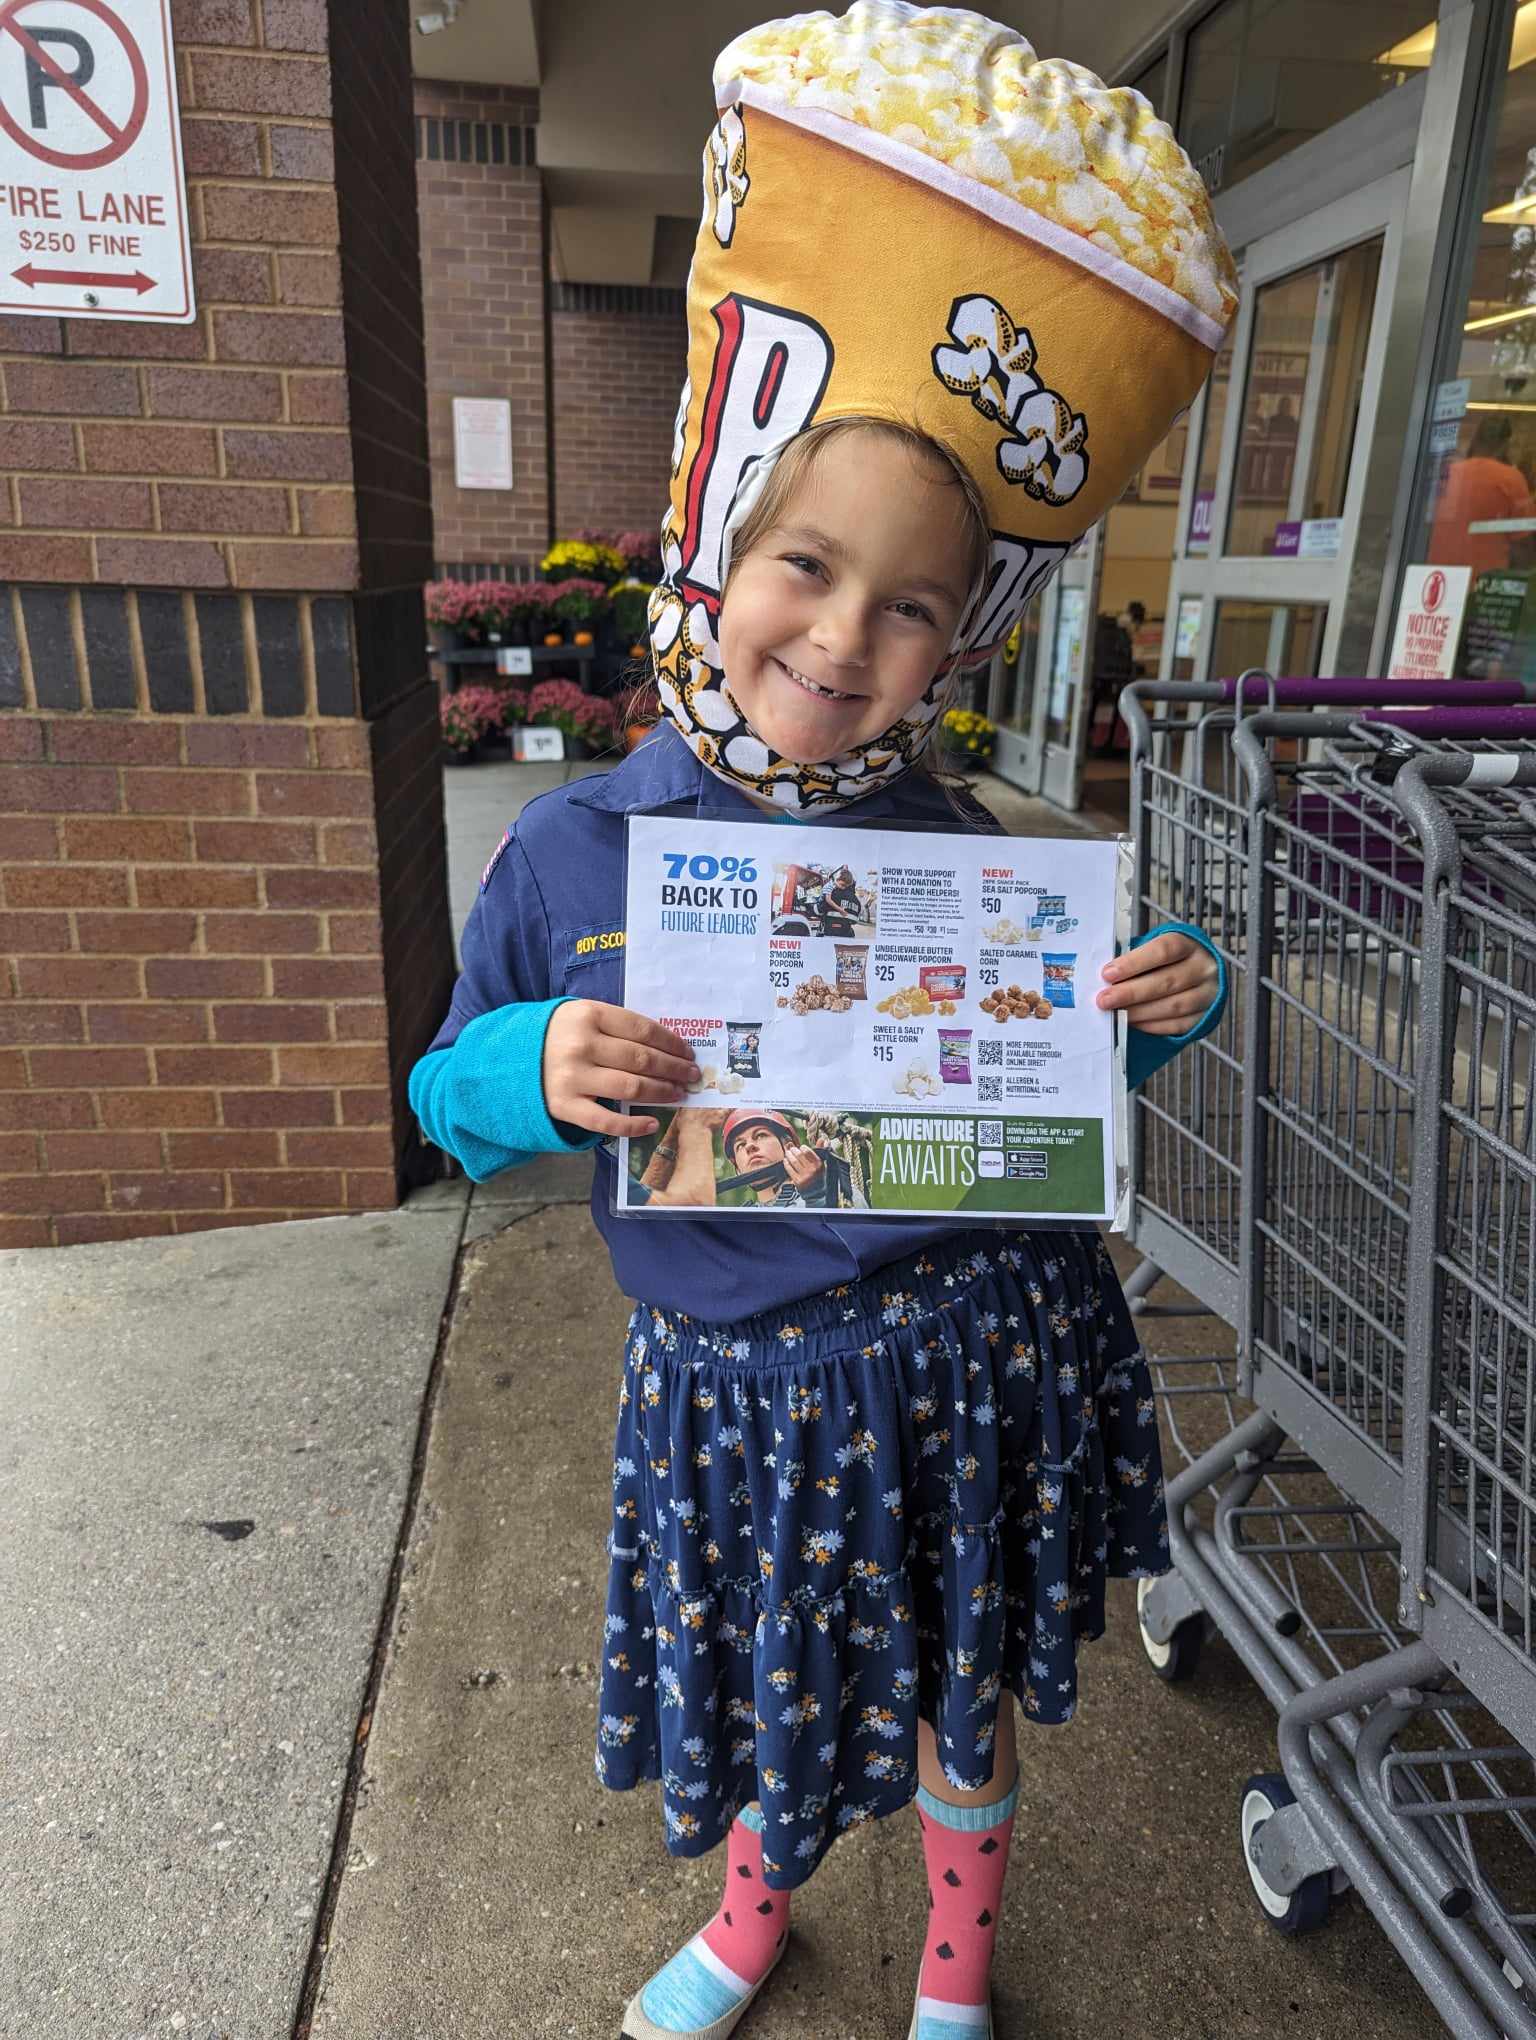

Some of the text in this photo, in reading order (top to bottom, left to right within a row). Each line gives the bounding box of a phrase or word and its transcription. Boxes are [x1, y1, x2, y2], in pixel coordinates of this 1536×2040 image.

[77, 189, 166, 226] LANE
[19, 230, 142, 257] $250 FINE
[1407, 614, 1450, 637] NOTICE
[663, 853, 758, 883] 70%
[882, 867, 957, 878] SHOW YOUR SUPPORT
[982, 868, 1014, 878] NEW!
[881, 876, 952, 888] WITH A DONATION TO
[881, 886, 960, 897] HEROES AND HELPERS!
[982, 885, 1047, 895] SEA SALT POPCORN
[661, 885, 758, 909] BACK TO
[981, 897, 1001, 913] $50
[661, 910, 705, 933] FUTURE
[576, 931, 626, 955] BOY SCO
[769, 940, 801, 950] NEW!
[769, 950, 801, 960] S'MORES
[875, 945, 926, 955] UNBELIEVABLE
[926, 946, 953, 956] BUTTER
[979, 949, 1038, 959] SALTED CARAMEL
[769, 959, 804, 968] POPCORN
[874, 953, 917, 963] MICROWAVE
[918, 954, 952, 964] POPCORN
[979, 957, 999, 966] CORN
[875, 965, 895, 982] $25
[979, 969, 999, 985] $25
[769, 971, 790, 988] $25
[660, 1017, 723, 1029] IMPROVED
[873, 1025, 924, 1036] SWEET & SALTY
[873, 1034, 919, 1044] KETTLE CORN
[1006, 1041, 1052, 1049] MORE PRODUCTS
[873, 1046, 893, 1062] $15
[1006, 1049, 1062, 1059] AVAILABLE THROUGH
[1006, 1058, 1047, 1067] ONLINE DIRECT
[1006, 1076, 1034, 1085] ALLERGEN
[1006, 1085, 1059, 1094] NUTRITIONAL FACTS
[879, 1117, 974, 1143] ADVENTURE
[1006, 1127, 1085, 1137] DOWNLOAD THE APP & START
[1006, 1135, 1075, 1145] YOUR ADVENTURE TODAY!
[879, 1144, 975, 1187] AWAITS
